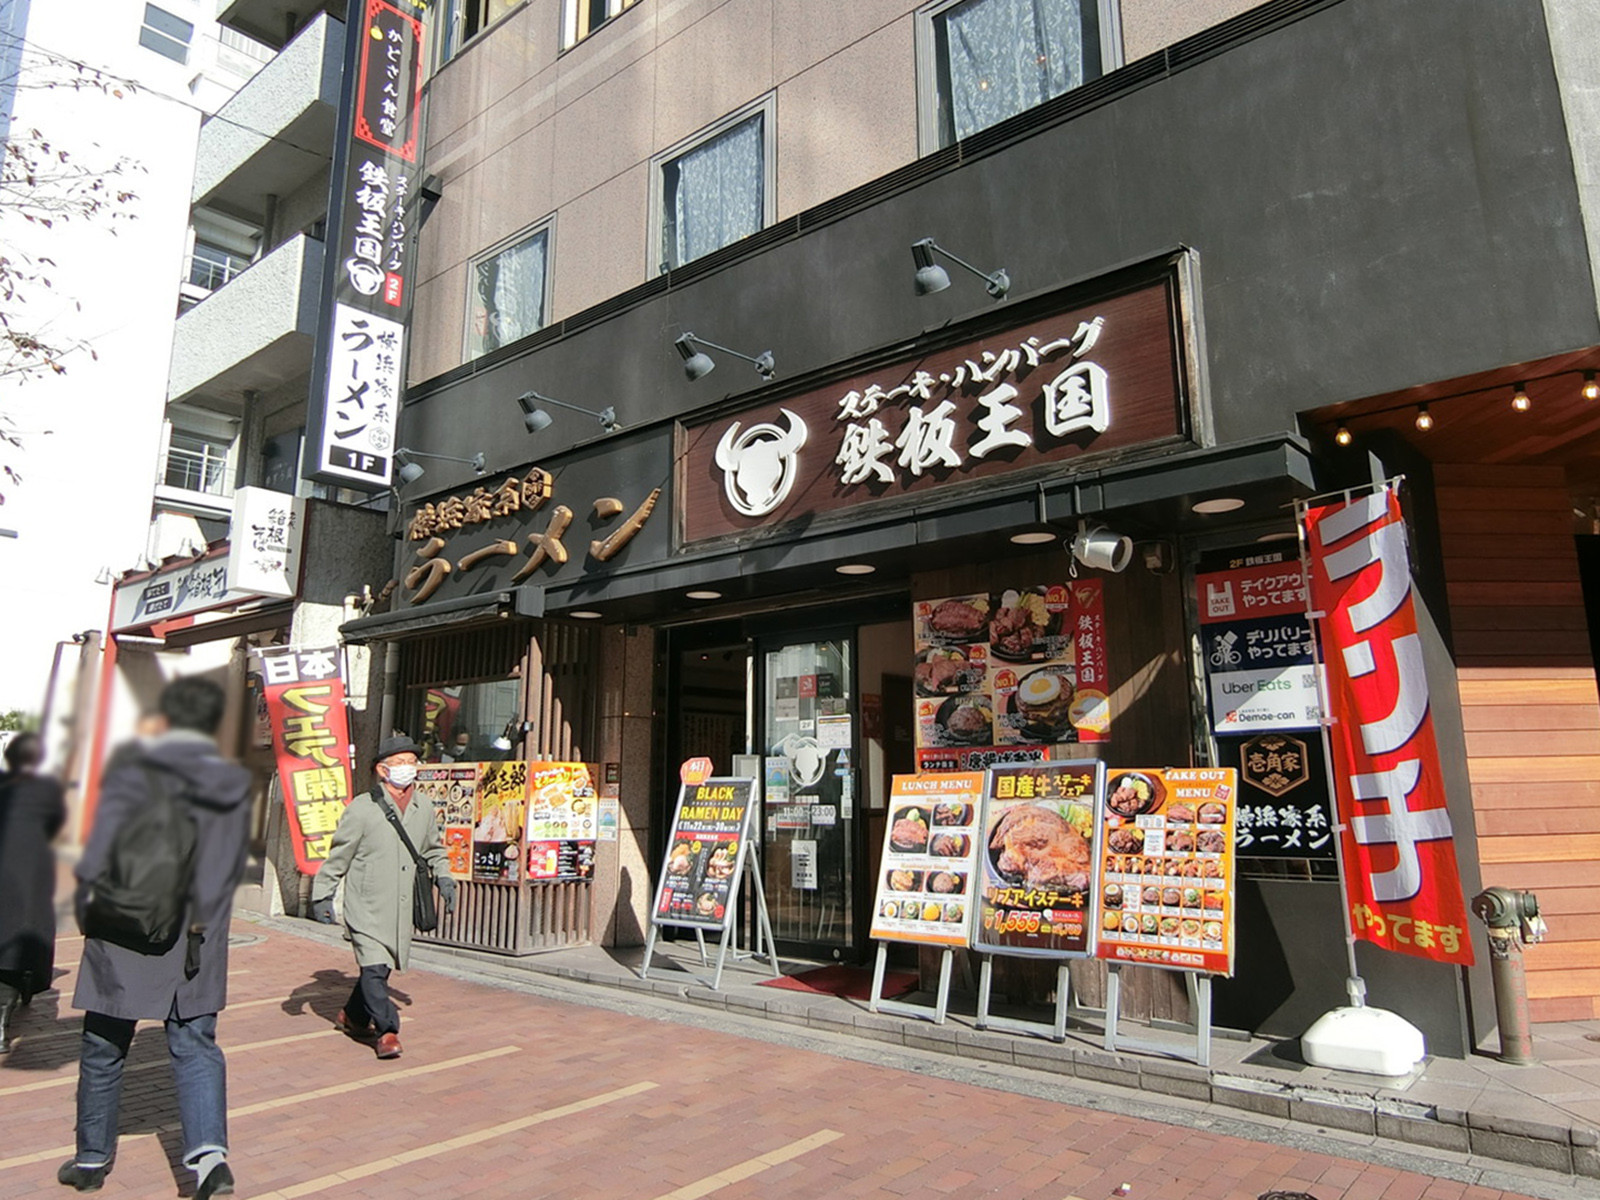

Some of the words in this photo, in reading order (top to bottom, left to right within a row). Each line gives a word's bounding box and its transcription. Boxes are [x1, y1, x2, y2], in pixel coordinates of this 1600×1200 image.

[355, 161, 390, 265] 鉄板王国
[388, 278, 399, 301] 2F
[837, 316, 1106, 421] ステーキ・ハンバーグ
[333, 320, 374, 440] ラーメン
[836, 361, 1109, 485] 鉄板王国
[348, 453, 375, 471] 1F
[404, 487, 662, 604] ラーメン
[1229, 559, 1244, 569] 2F
[1211, 597, 1231, 605] TAKE
[1078, 614, 1096, 684] 鉄板王国
[1222, 681, 1254, 694] Uber
[1257, 678, 1292, 691] Eats
[1318, 491, 1453, 902] ランチ
[1239, 711, 1295, 723] Demae-can
[1248, 752, 1300, 773] 壱角家
[902, 780, 938, 791] LUNCH
[940, 779, 972, 789] MENU
[996, 774, 1051, 798] 国産牛
[1053, 774, 1092, 786] ステーキ
[1165, 770, 1196, 781] TAKE
[1200, 770, 1226, 780] OUT
[696, 786, 736, 801] BLACK
[1058, 785, 1084, 798] フェア
[1176, 788, 1211, 798] MENU
[680, 806, 719, 821] RAMEN
[721, 807, 744, 822] DAY
[1236, 804, 1327, 829] 横浜家系
[1235, 828, 1331, 850] ラーメン
[988, 887, 1084, 908] リブアイステーキ
[1352, 902, 1463, 954] やってます
